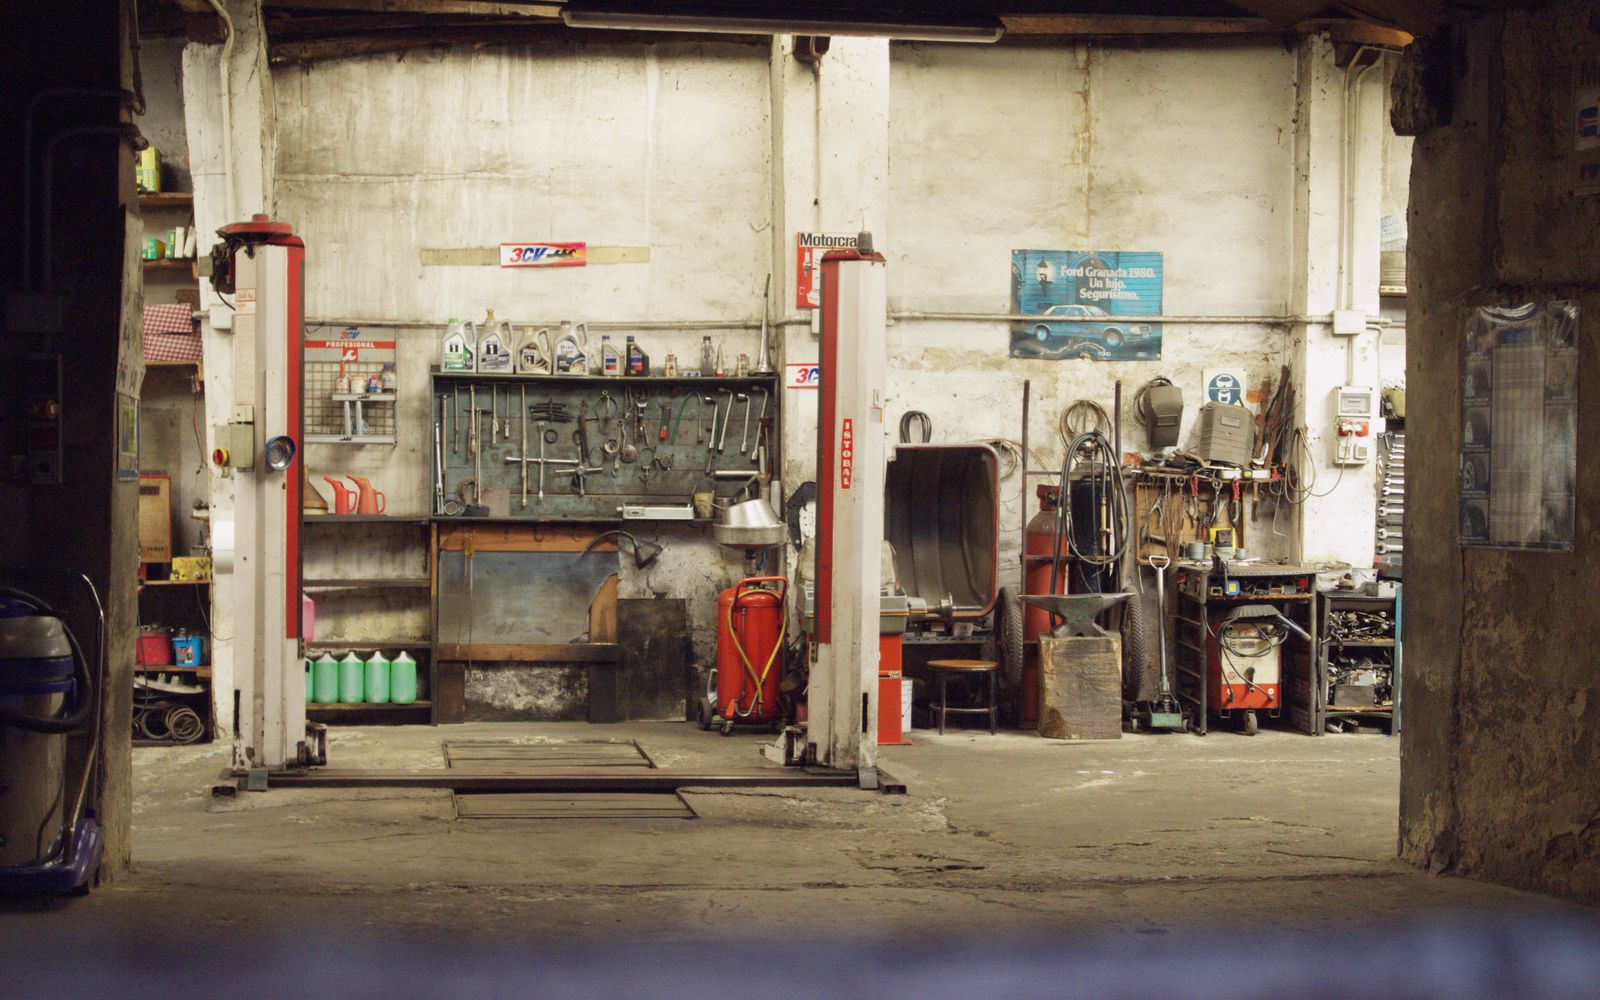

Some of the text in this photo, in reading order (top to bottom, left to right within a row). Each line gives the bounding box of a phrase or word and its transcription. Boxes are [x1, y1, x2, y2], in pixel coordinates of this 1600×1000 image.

[800, 233, 857, 247] Motorcra
[510, 247, 548, 262] 3CV
[1060, 266, 1083, 276] Ford
[1085, 266, 1127, 277] Granada
[1089, 278, 1127, 291] Un lujo.
[340, 330, 360, 339] 3CV
[795, 368, 818, 383] 3C
[842, 422, 852, 485] ISTOBAL
